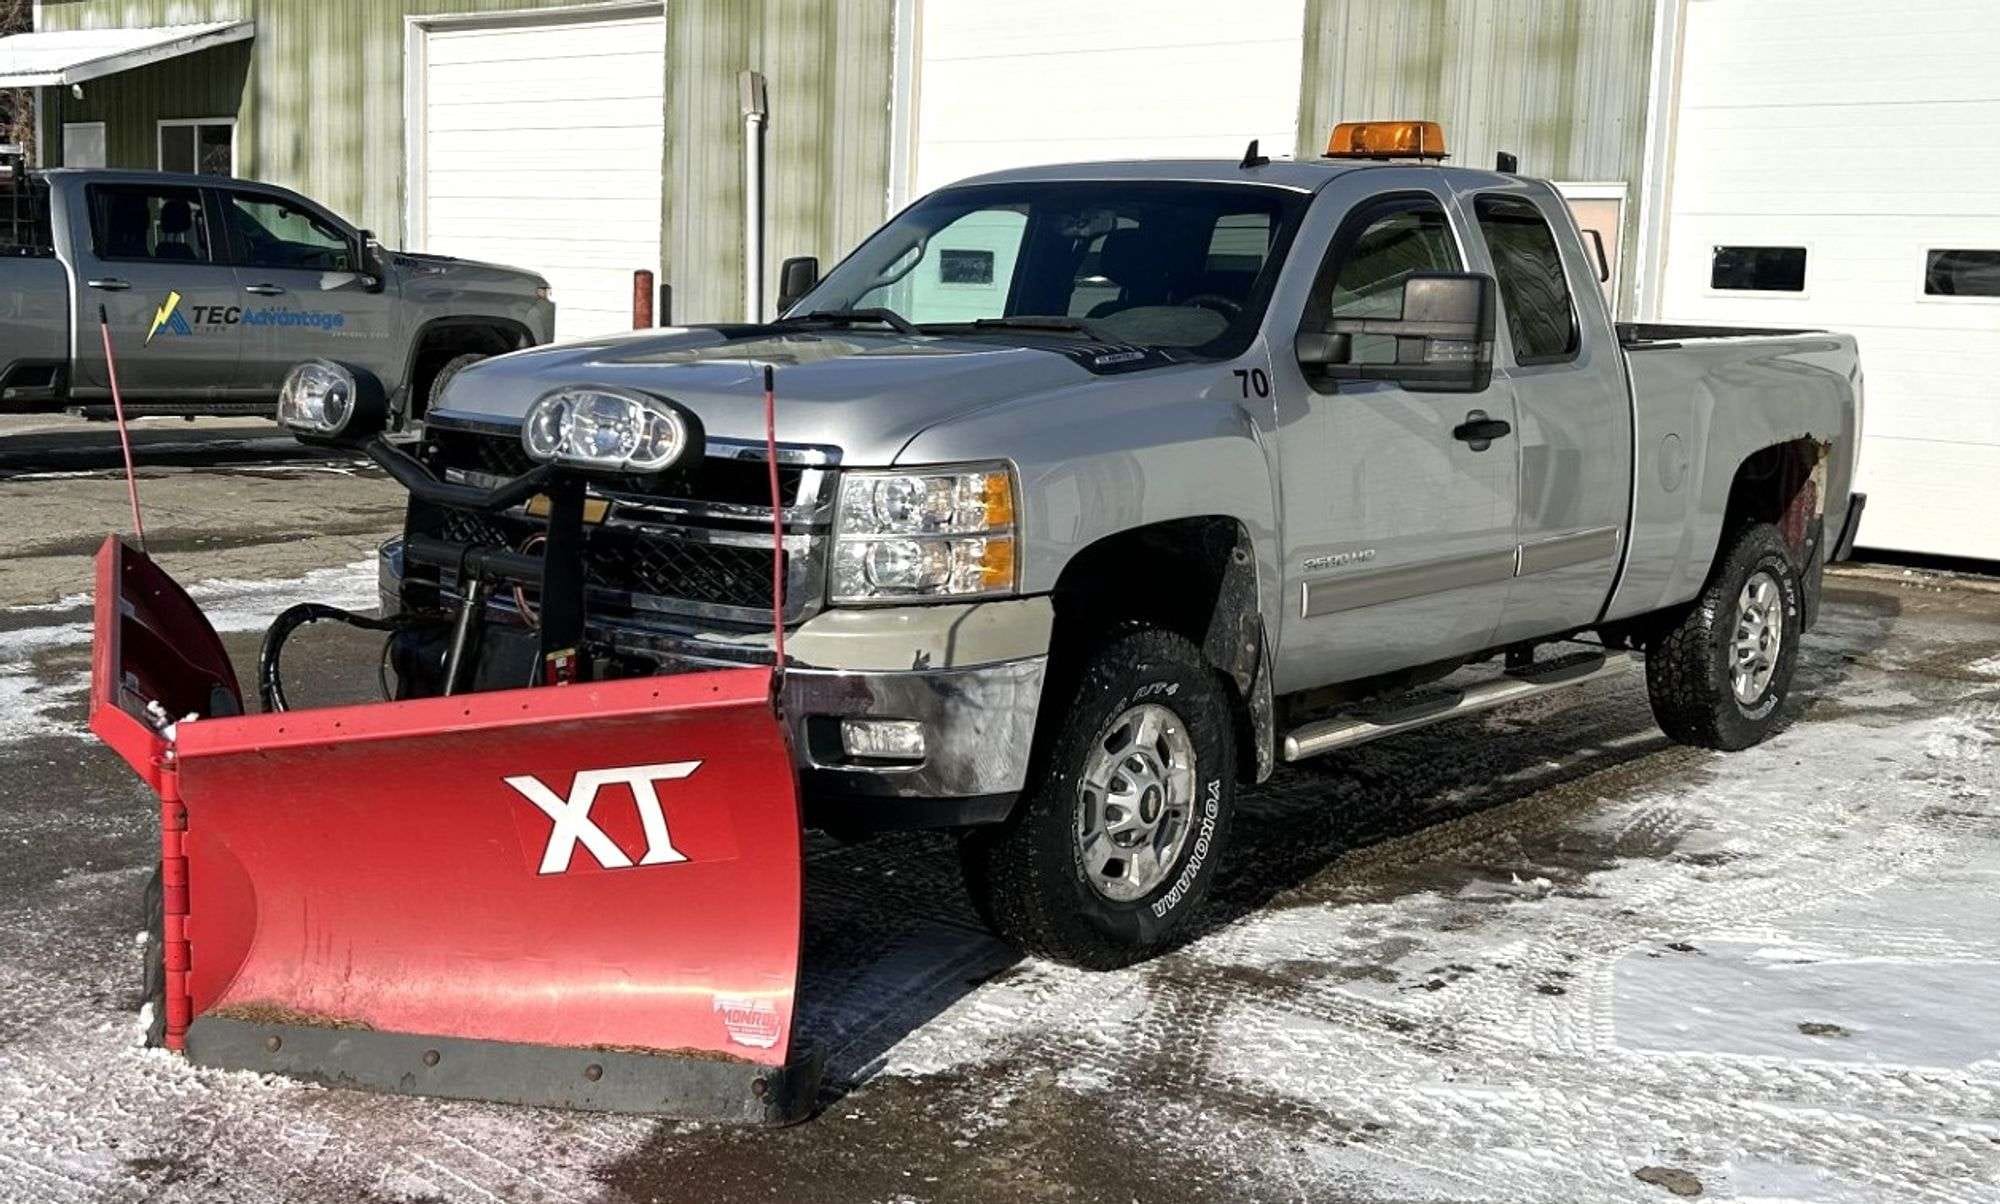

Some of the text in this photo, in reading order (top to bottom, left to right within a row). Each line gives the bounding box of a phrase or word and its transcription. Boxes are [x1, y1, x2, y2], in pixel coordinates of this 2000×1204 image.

[192, 306, 241, 325] TEC
[1233, 367, 1269, 398] 70
[504, 760, 704, 876] XT
[1151, 778, 1221, 918] YOKOHAMA
